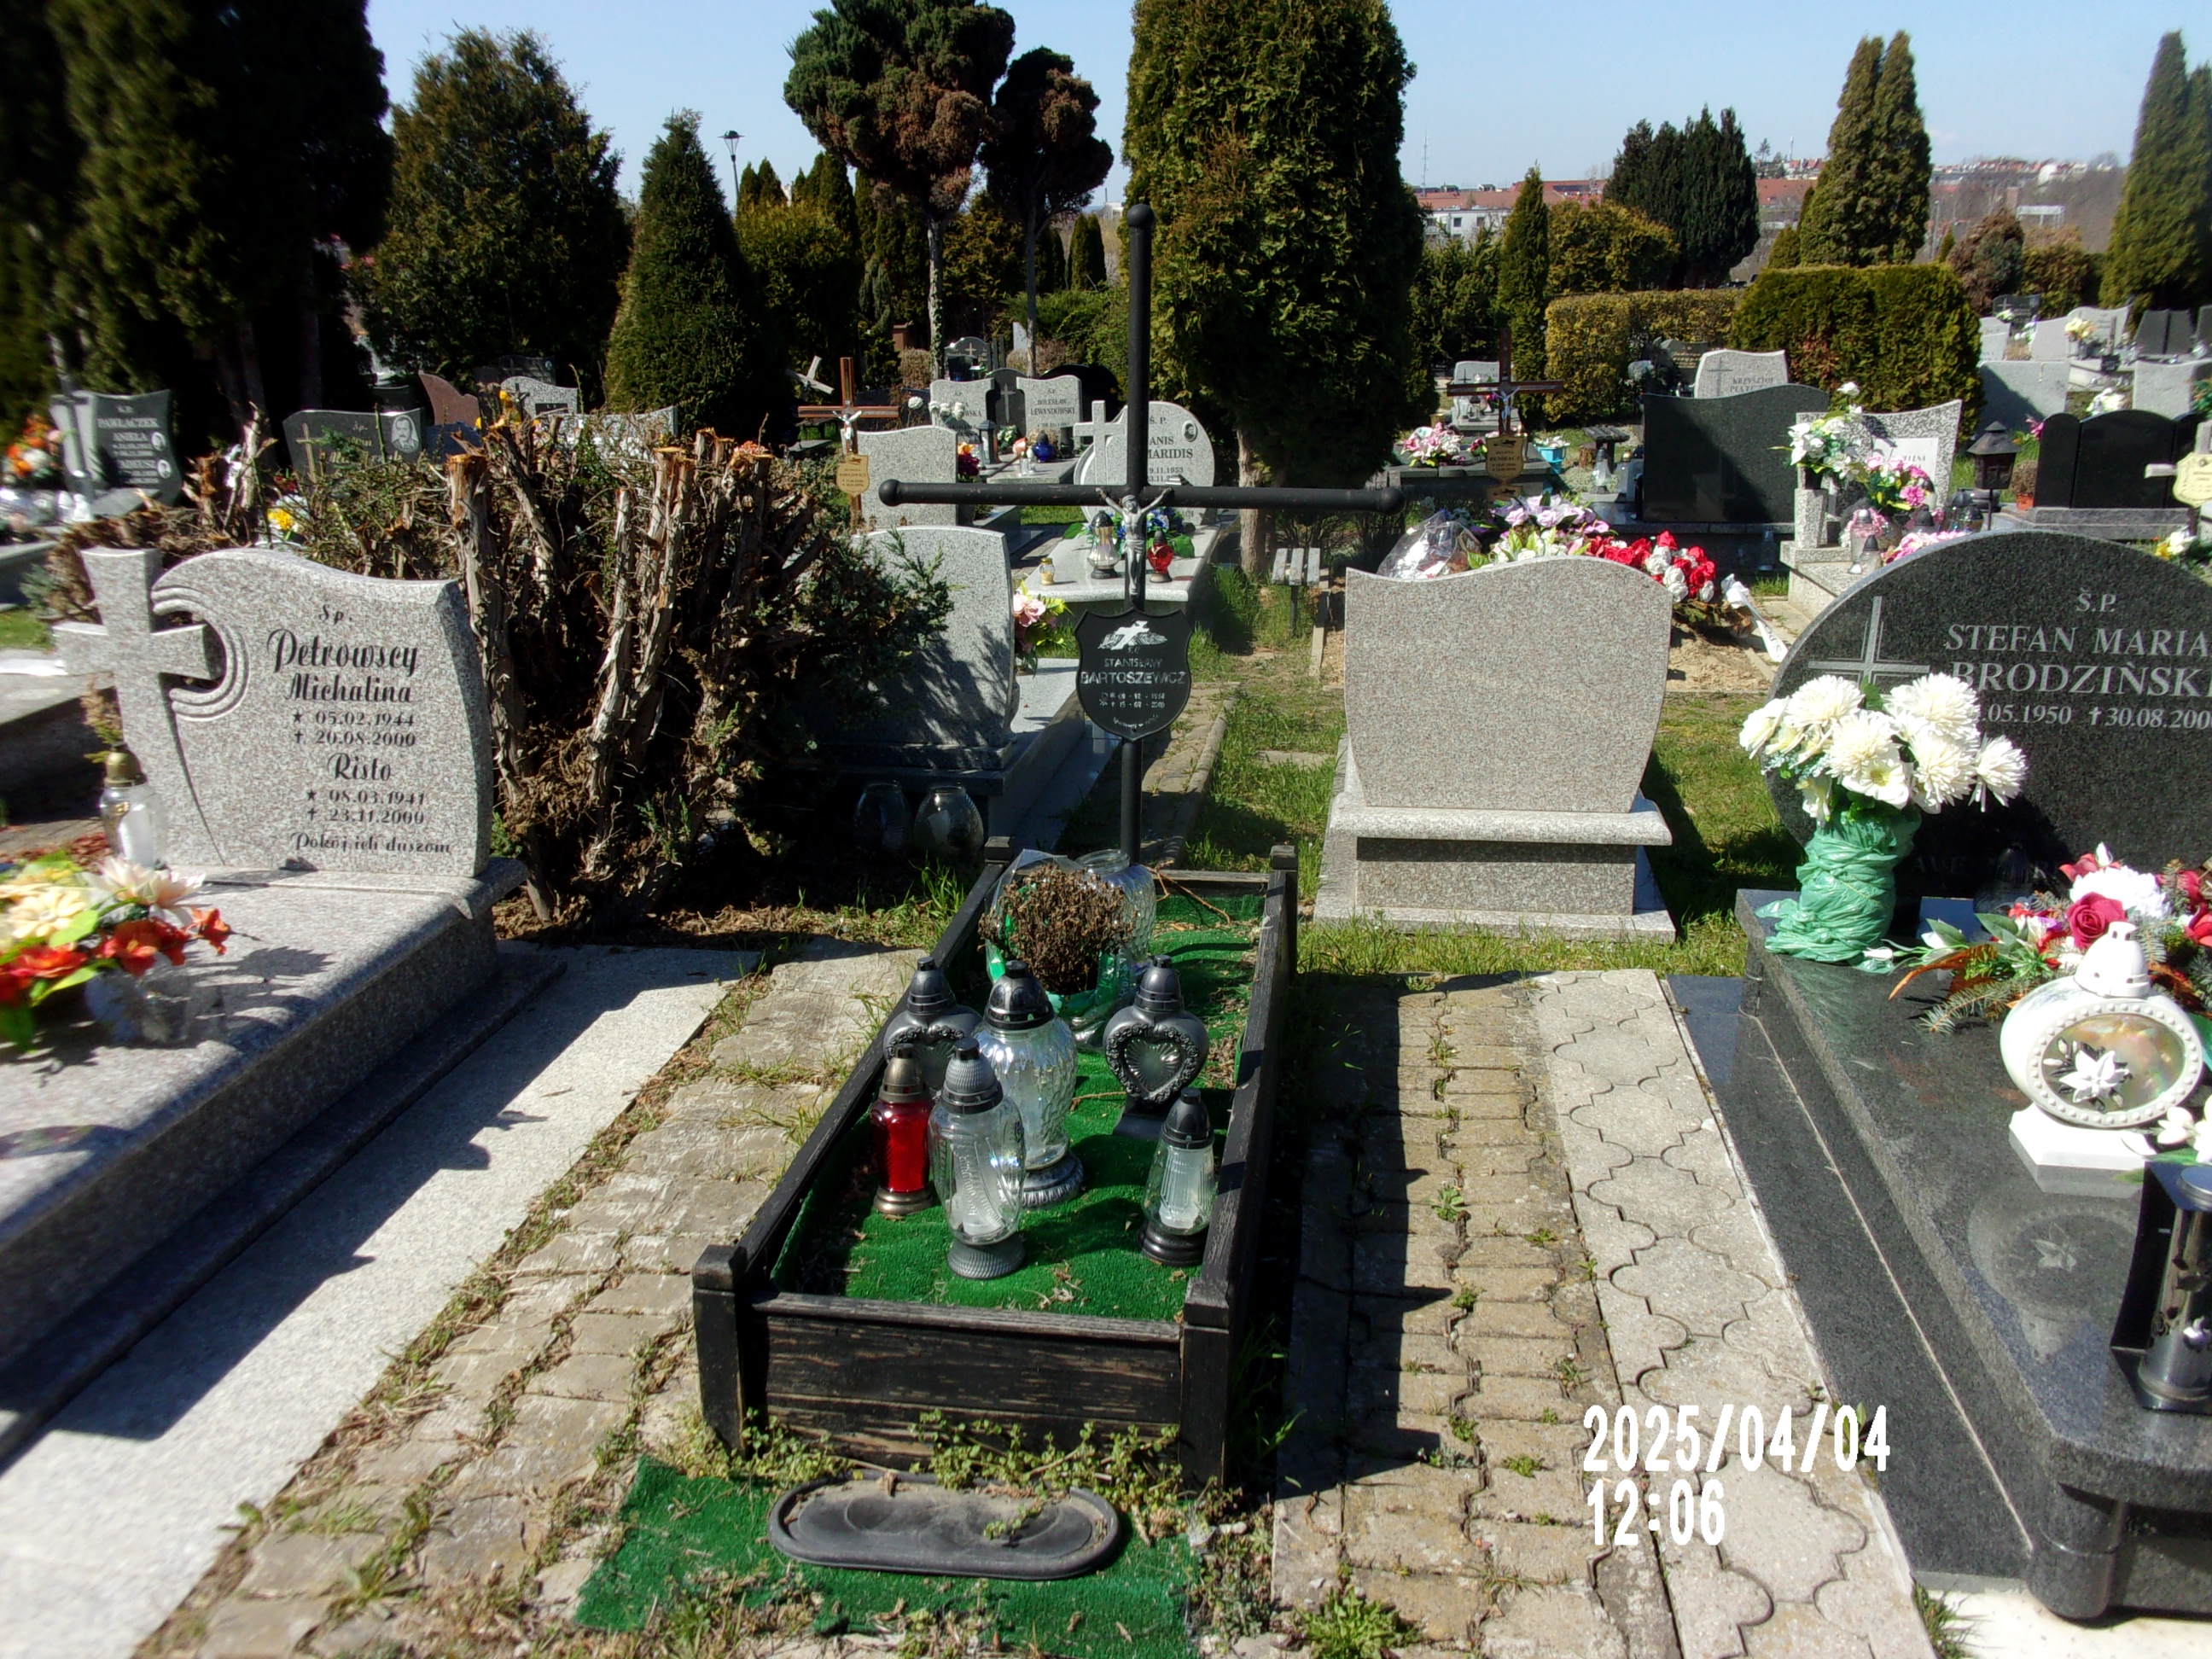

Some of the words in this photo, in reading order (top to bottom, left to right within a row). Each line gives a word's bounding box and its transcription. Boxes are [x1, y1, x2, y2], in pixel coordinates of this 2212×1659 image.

[1149, 436, 1174, 445] ANIS
[1945, 623, 2079, 653] STEFAN
[2092, 627, 2212, 657] MARIA
[266, 628, 418, 677] Petrowscy
[1080, 671, 1187, 684] BARTOSZEWICZ
[284, 672, 413, 703] Michalina
[315, 711, 415, 726] 05.02.1944
[1981, 703, 2073, 725] .05.1950
[2104, 707, 2212, 731] 30.08.200
[315, 730, 416, 748] 20.08.2000
[327, 752, 392, 781] Risto
[329, 789, 425, 806] 08.03.1941
[329, 807, 425, 824] 23.11.2000
